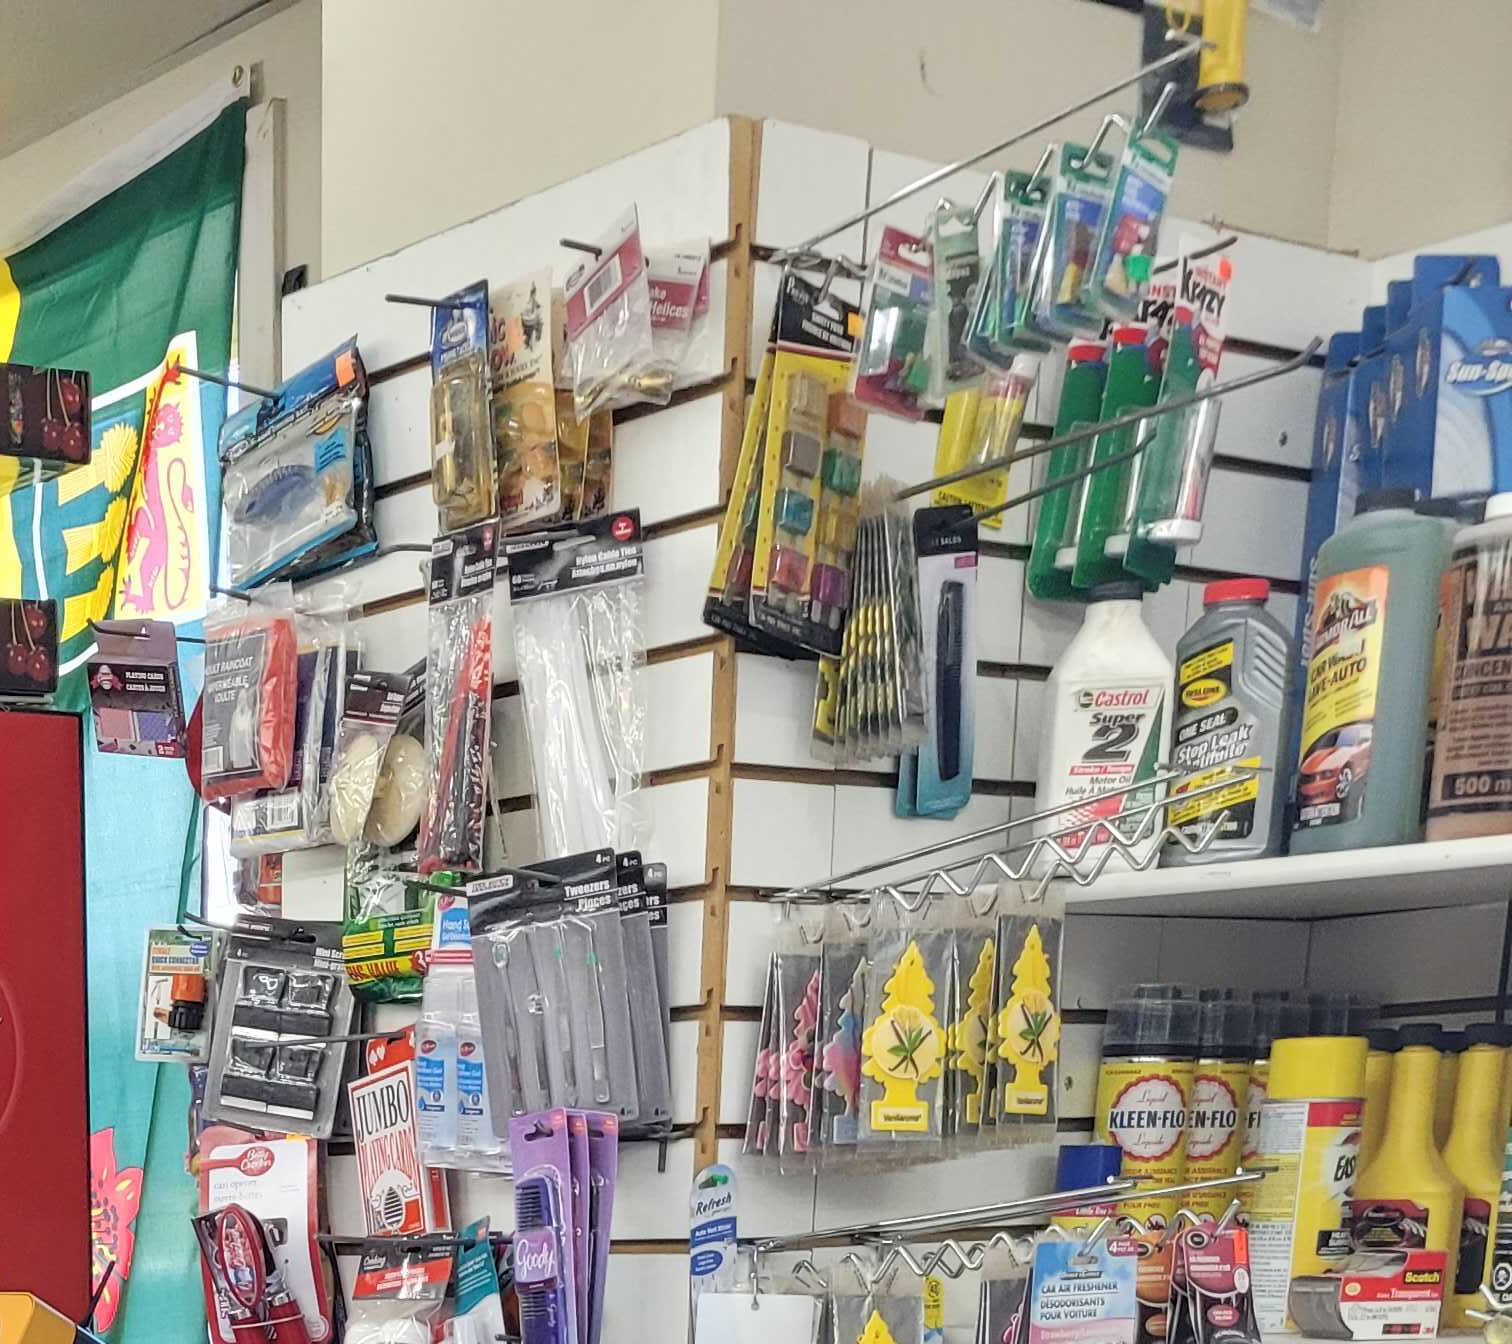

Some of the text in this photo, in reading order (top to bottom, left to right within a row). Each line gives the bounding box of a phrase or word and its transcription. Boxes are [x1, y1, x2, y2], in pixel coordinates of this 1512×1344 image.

[1095, 690, 1150, 708] Castrol
[1090, 712, 1146, 727] Super
[1199, 713, 1226, 733] SEAL
[1082, 725, 1139, 763] 2
[1178, 724, 1254, 765] Stop Leak
[1090, 776, 1131, 785] Motor Oil
[564, 880, 610, 898] Tweezers
[442, 919, 461, 933] Hand
[367, 960, 400, 977] VALUE
[356, 1078, 409, 1144] JUMBO
[1109, 1109, 1186, 1130] KLEEN-FLO
[695, 1191, 733, 1217] Refresh
[515, 1239, 555, 1276] Goody
[1404, 1271, 1440, 1284] Scotch
[1041, 1280, 1118, 1294] CAR AIR FRESHENER
[1040, 1309, 1097, 1320] POUR VOITURE
